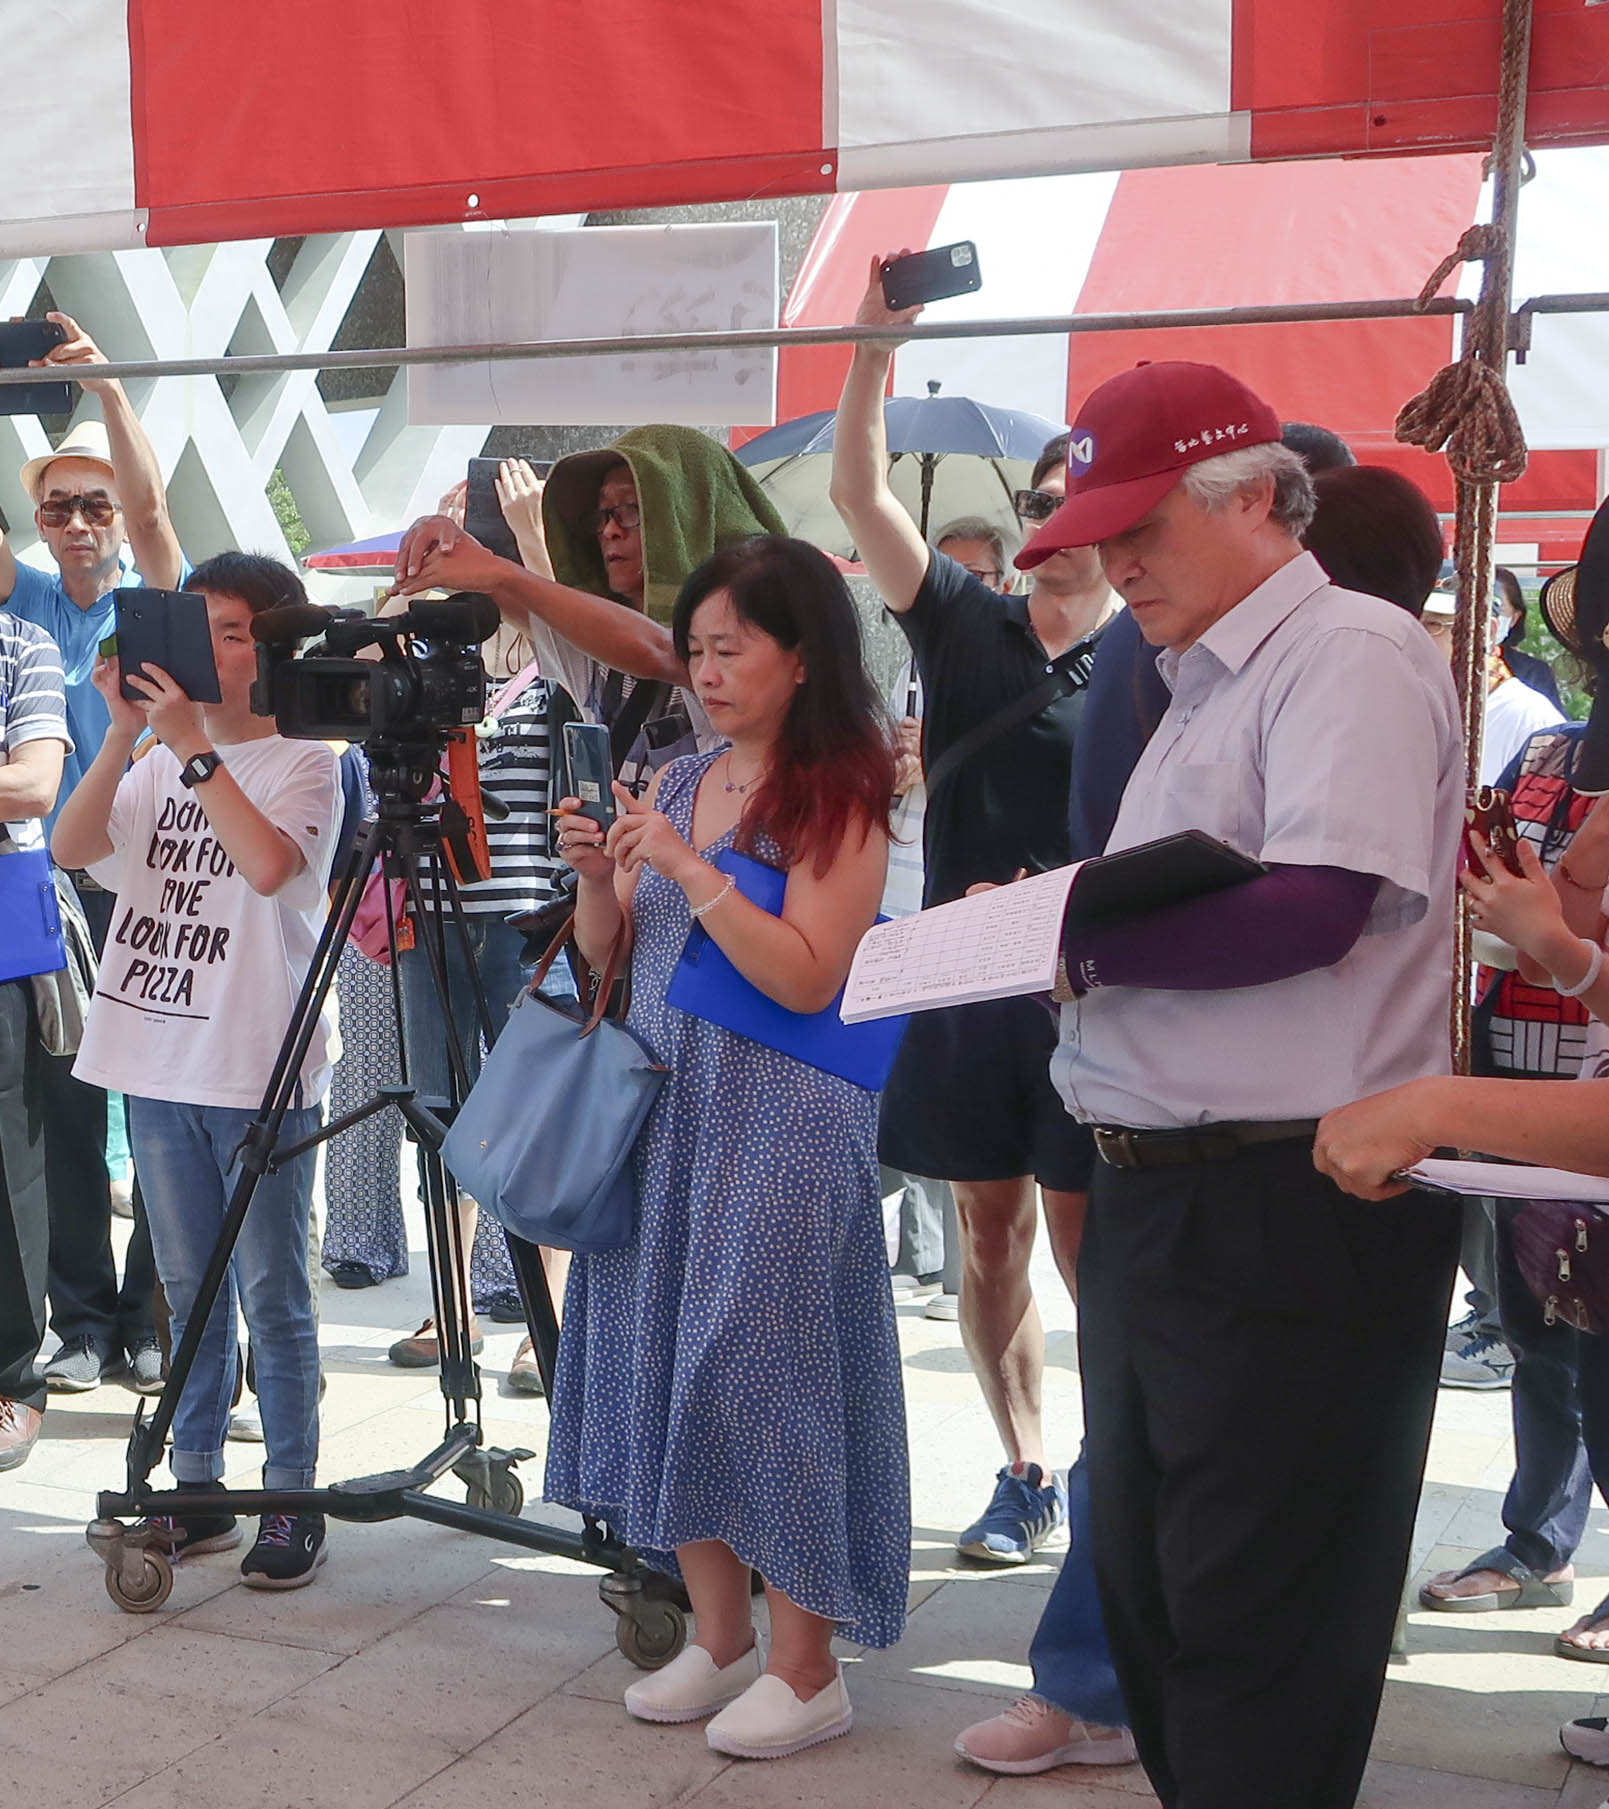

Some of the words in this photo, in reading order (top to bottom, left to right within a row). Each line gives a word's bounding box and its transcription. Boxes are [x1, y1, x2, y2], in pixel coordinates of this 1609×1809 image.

[157, 797, 210, 832] DON
[174, 924, 230, 965] FOR
[120, 958, 194, 1007] PIZZA
